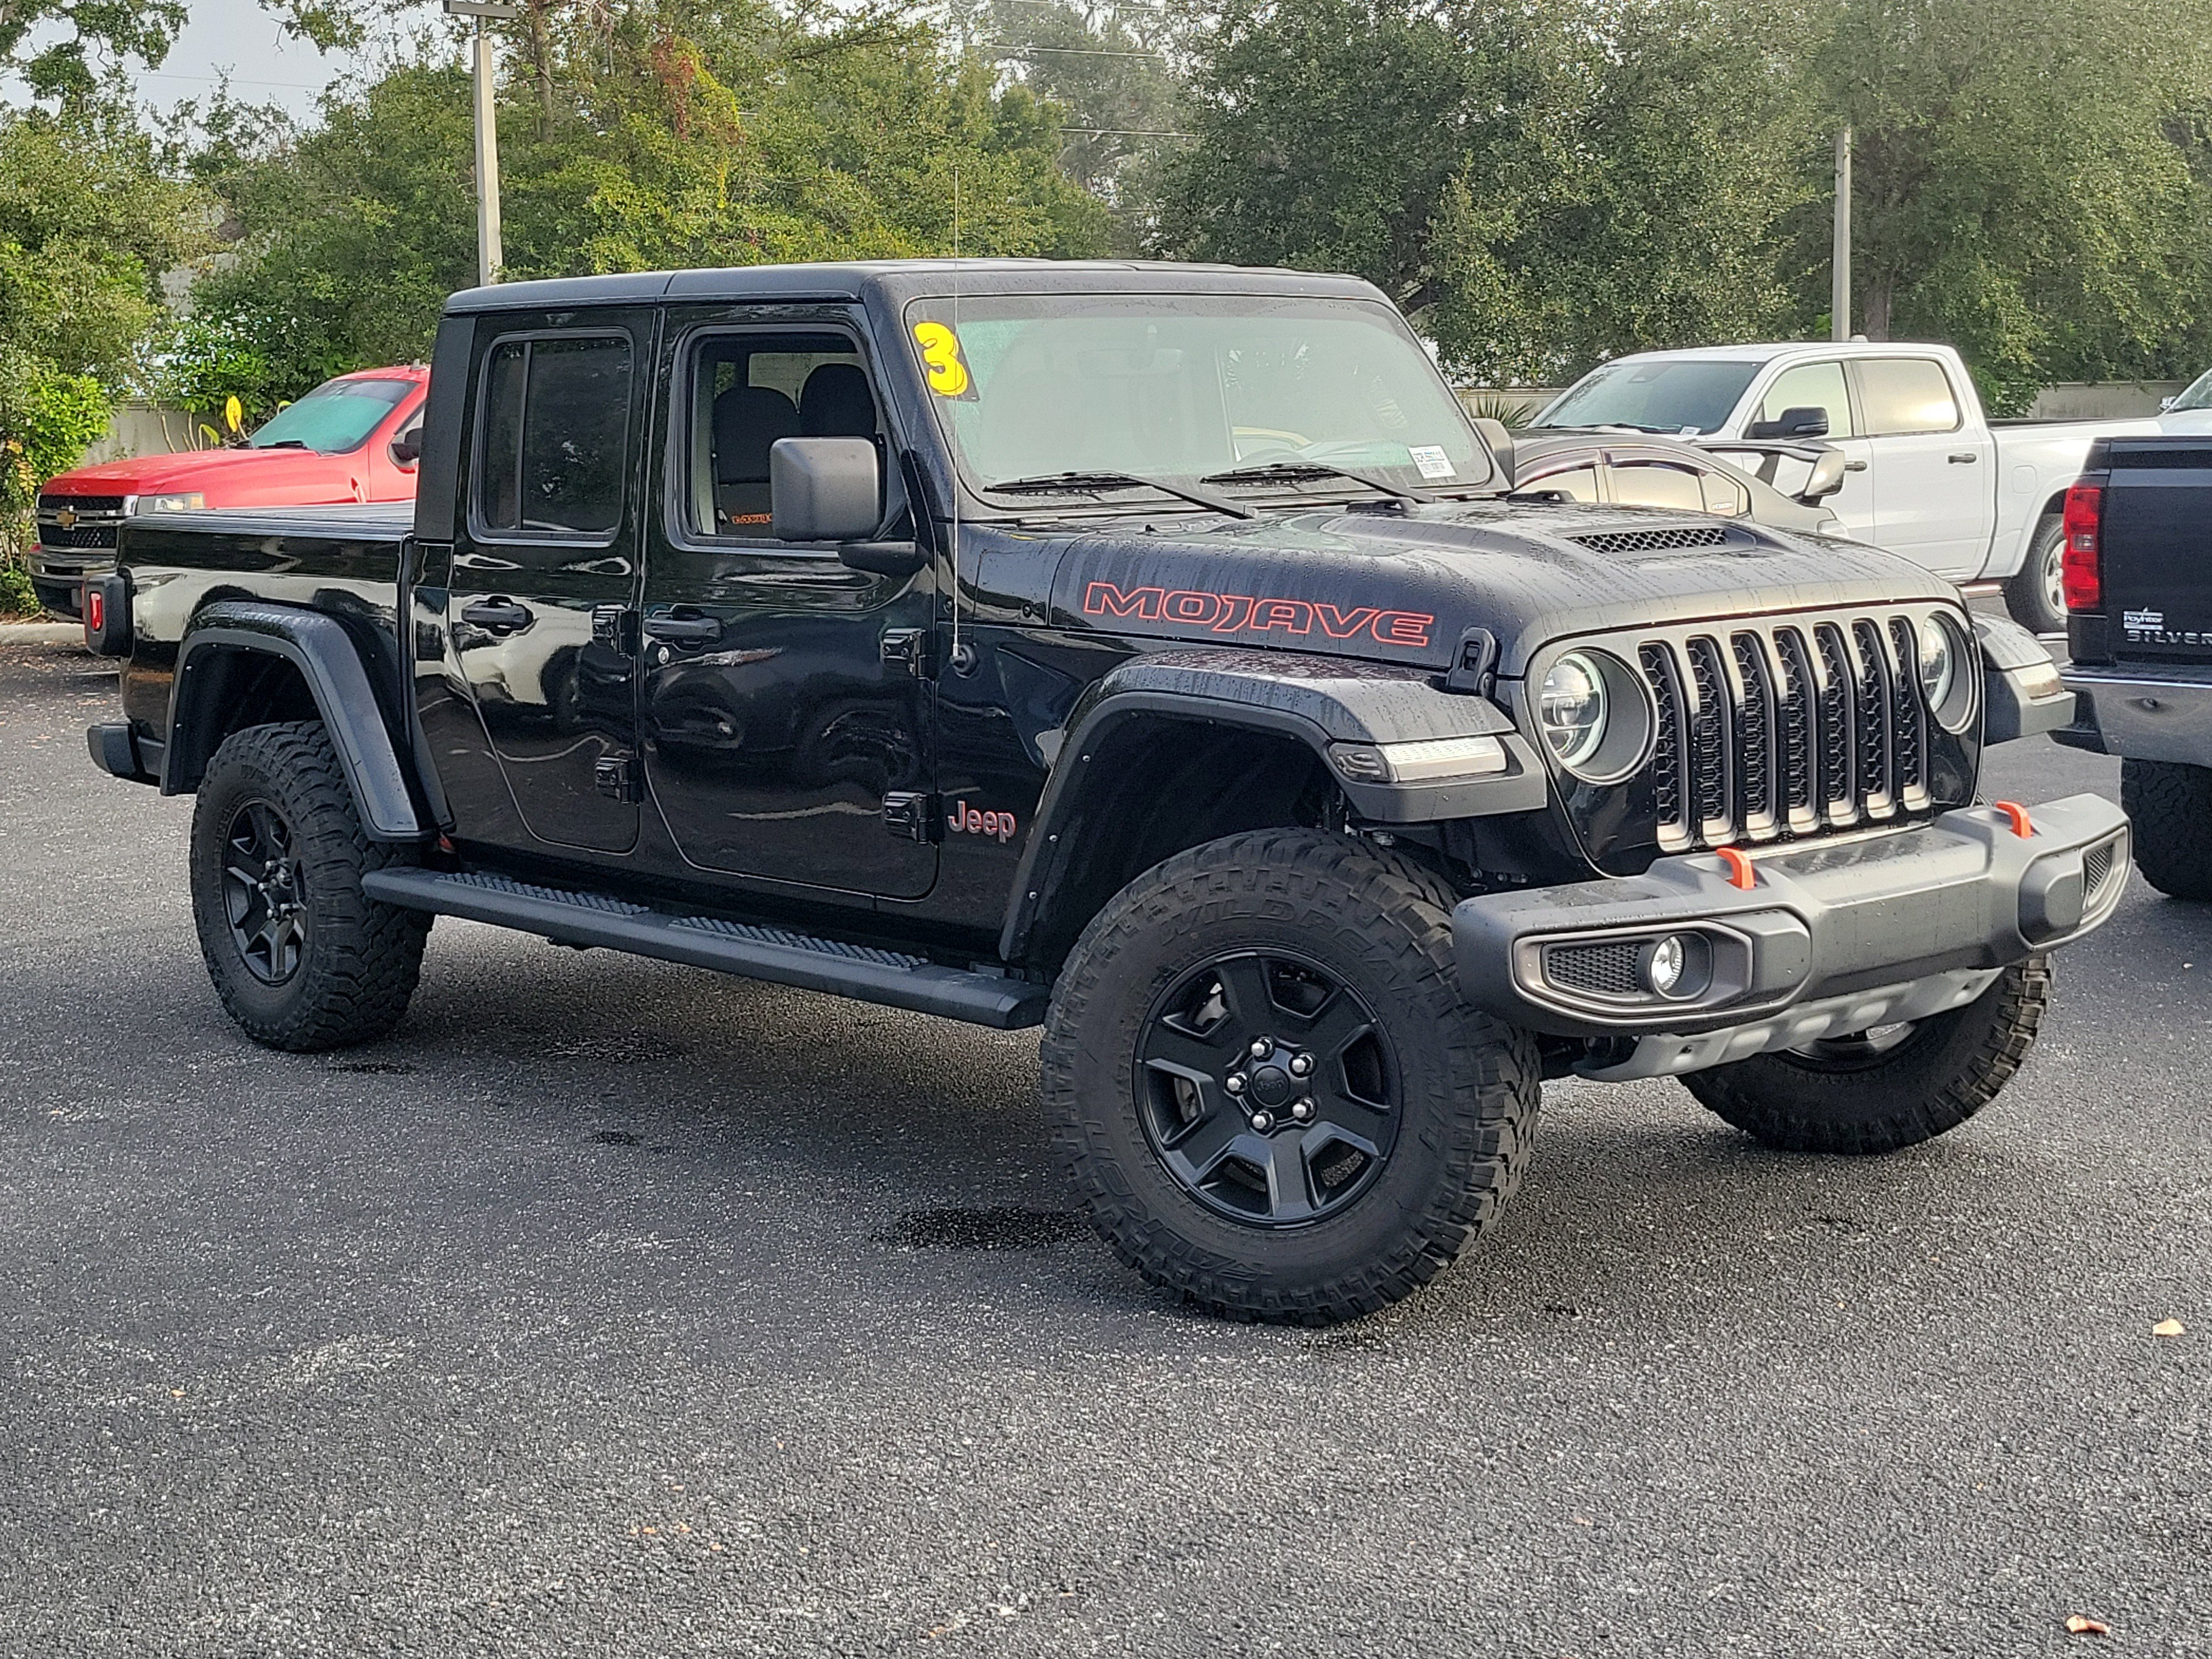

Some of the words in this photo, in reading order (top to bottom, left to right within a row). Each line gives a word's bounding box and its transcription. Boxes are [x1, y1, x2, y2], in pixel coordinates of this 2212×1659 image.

[913, 321, 968, 396] 3
[1084, 583, 1434, 646] MOJAVE
[2126, 630, 2212, 644] SILVER
[947, 800, 1016, 844] Jeep
